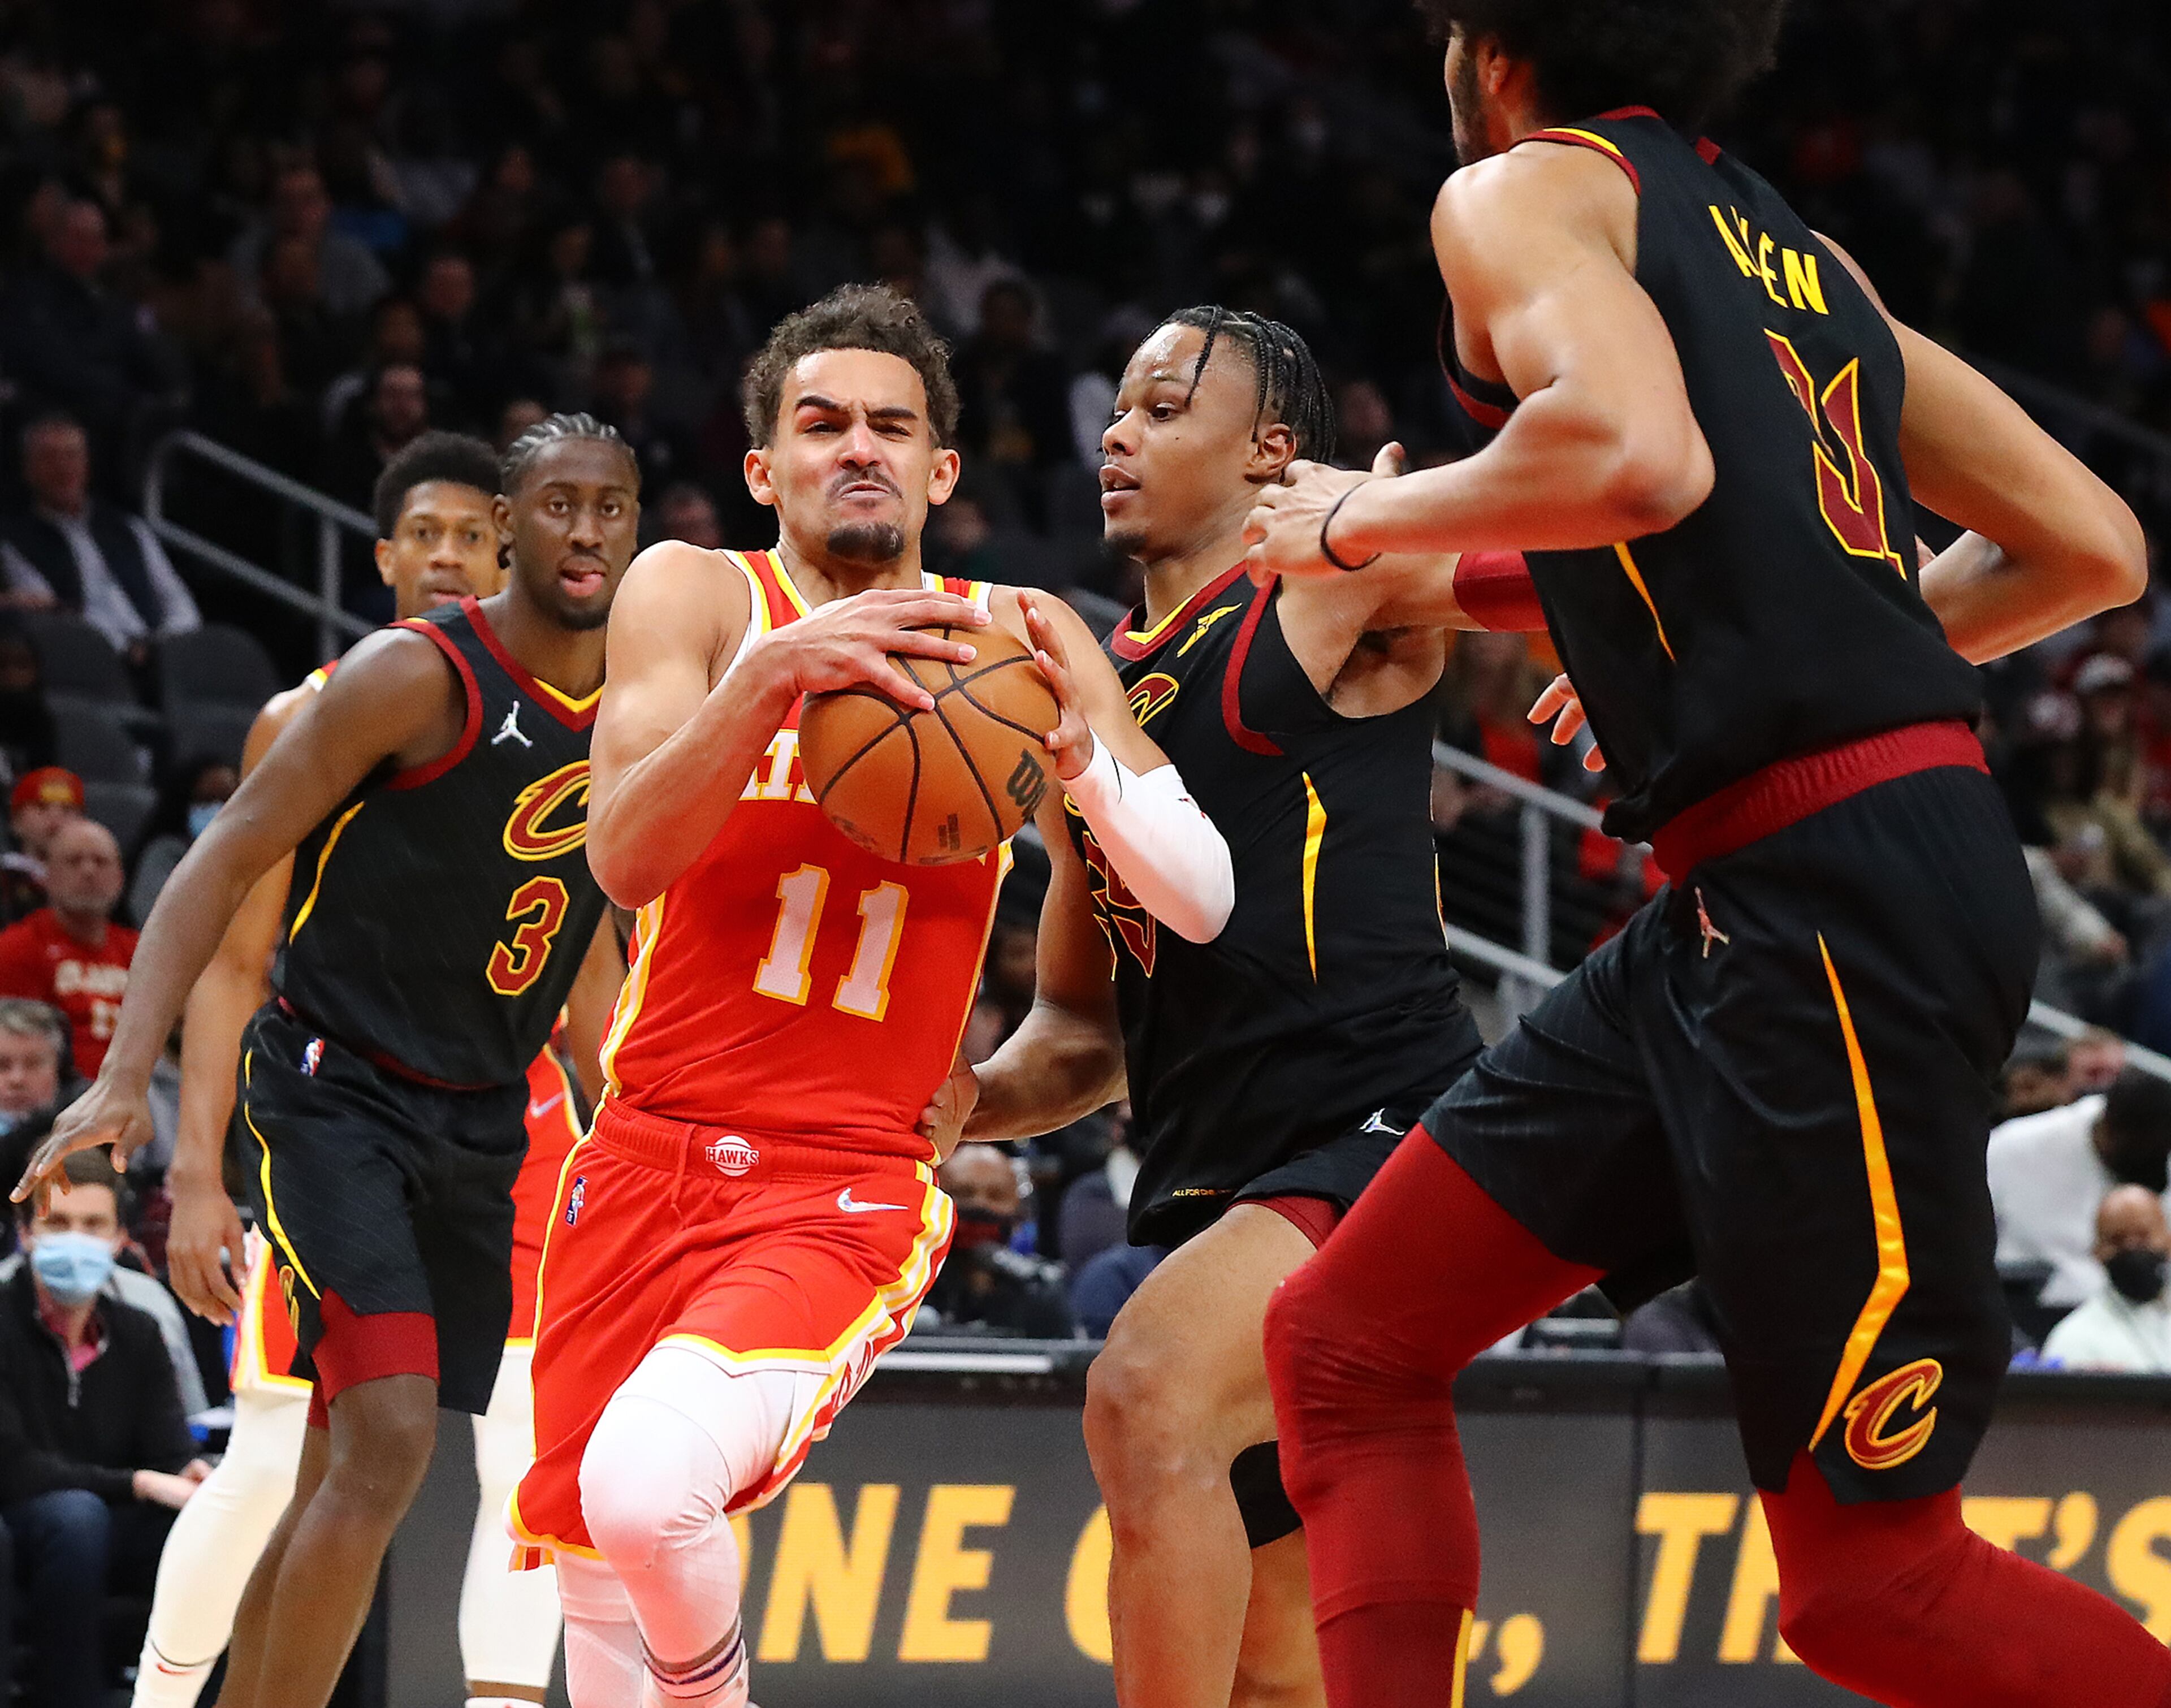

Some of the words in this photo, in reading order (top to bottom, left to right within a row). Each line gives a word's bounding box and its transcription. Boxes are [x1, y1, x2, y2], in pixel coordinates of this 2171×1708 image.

[486, 875, 570, 996] 3
[752, 862, 910, 1022] 11
[706, 1146, 759, 1165] HAWKS
[725, 1482, 1017, 1663] NE
